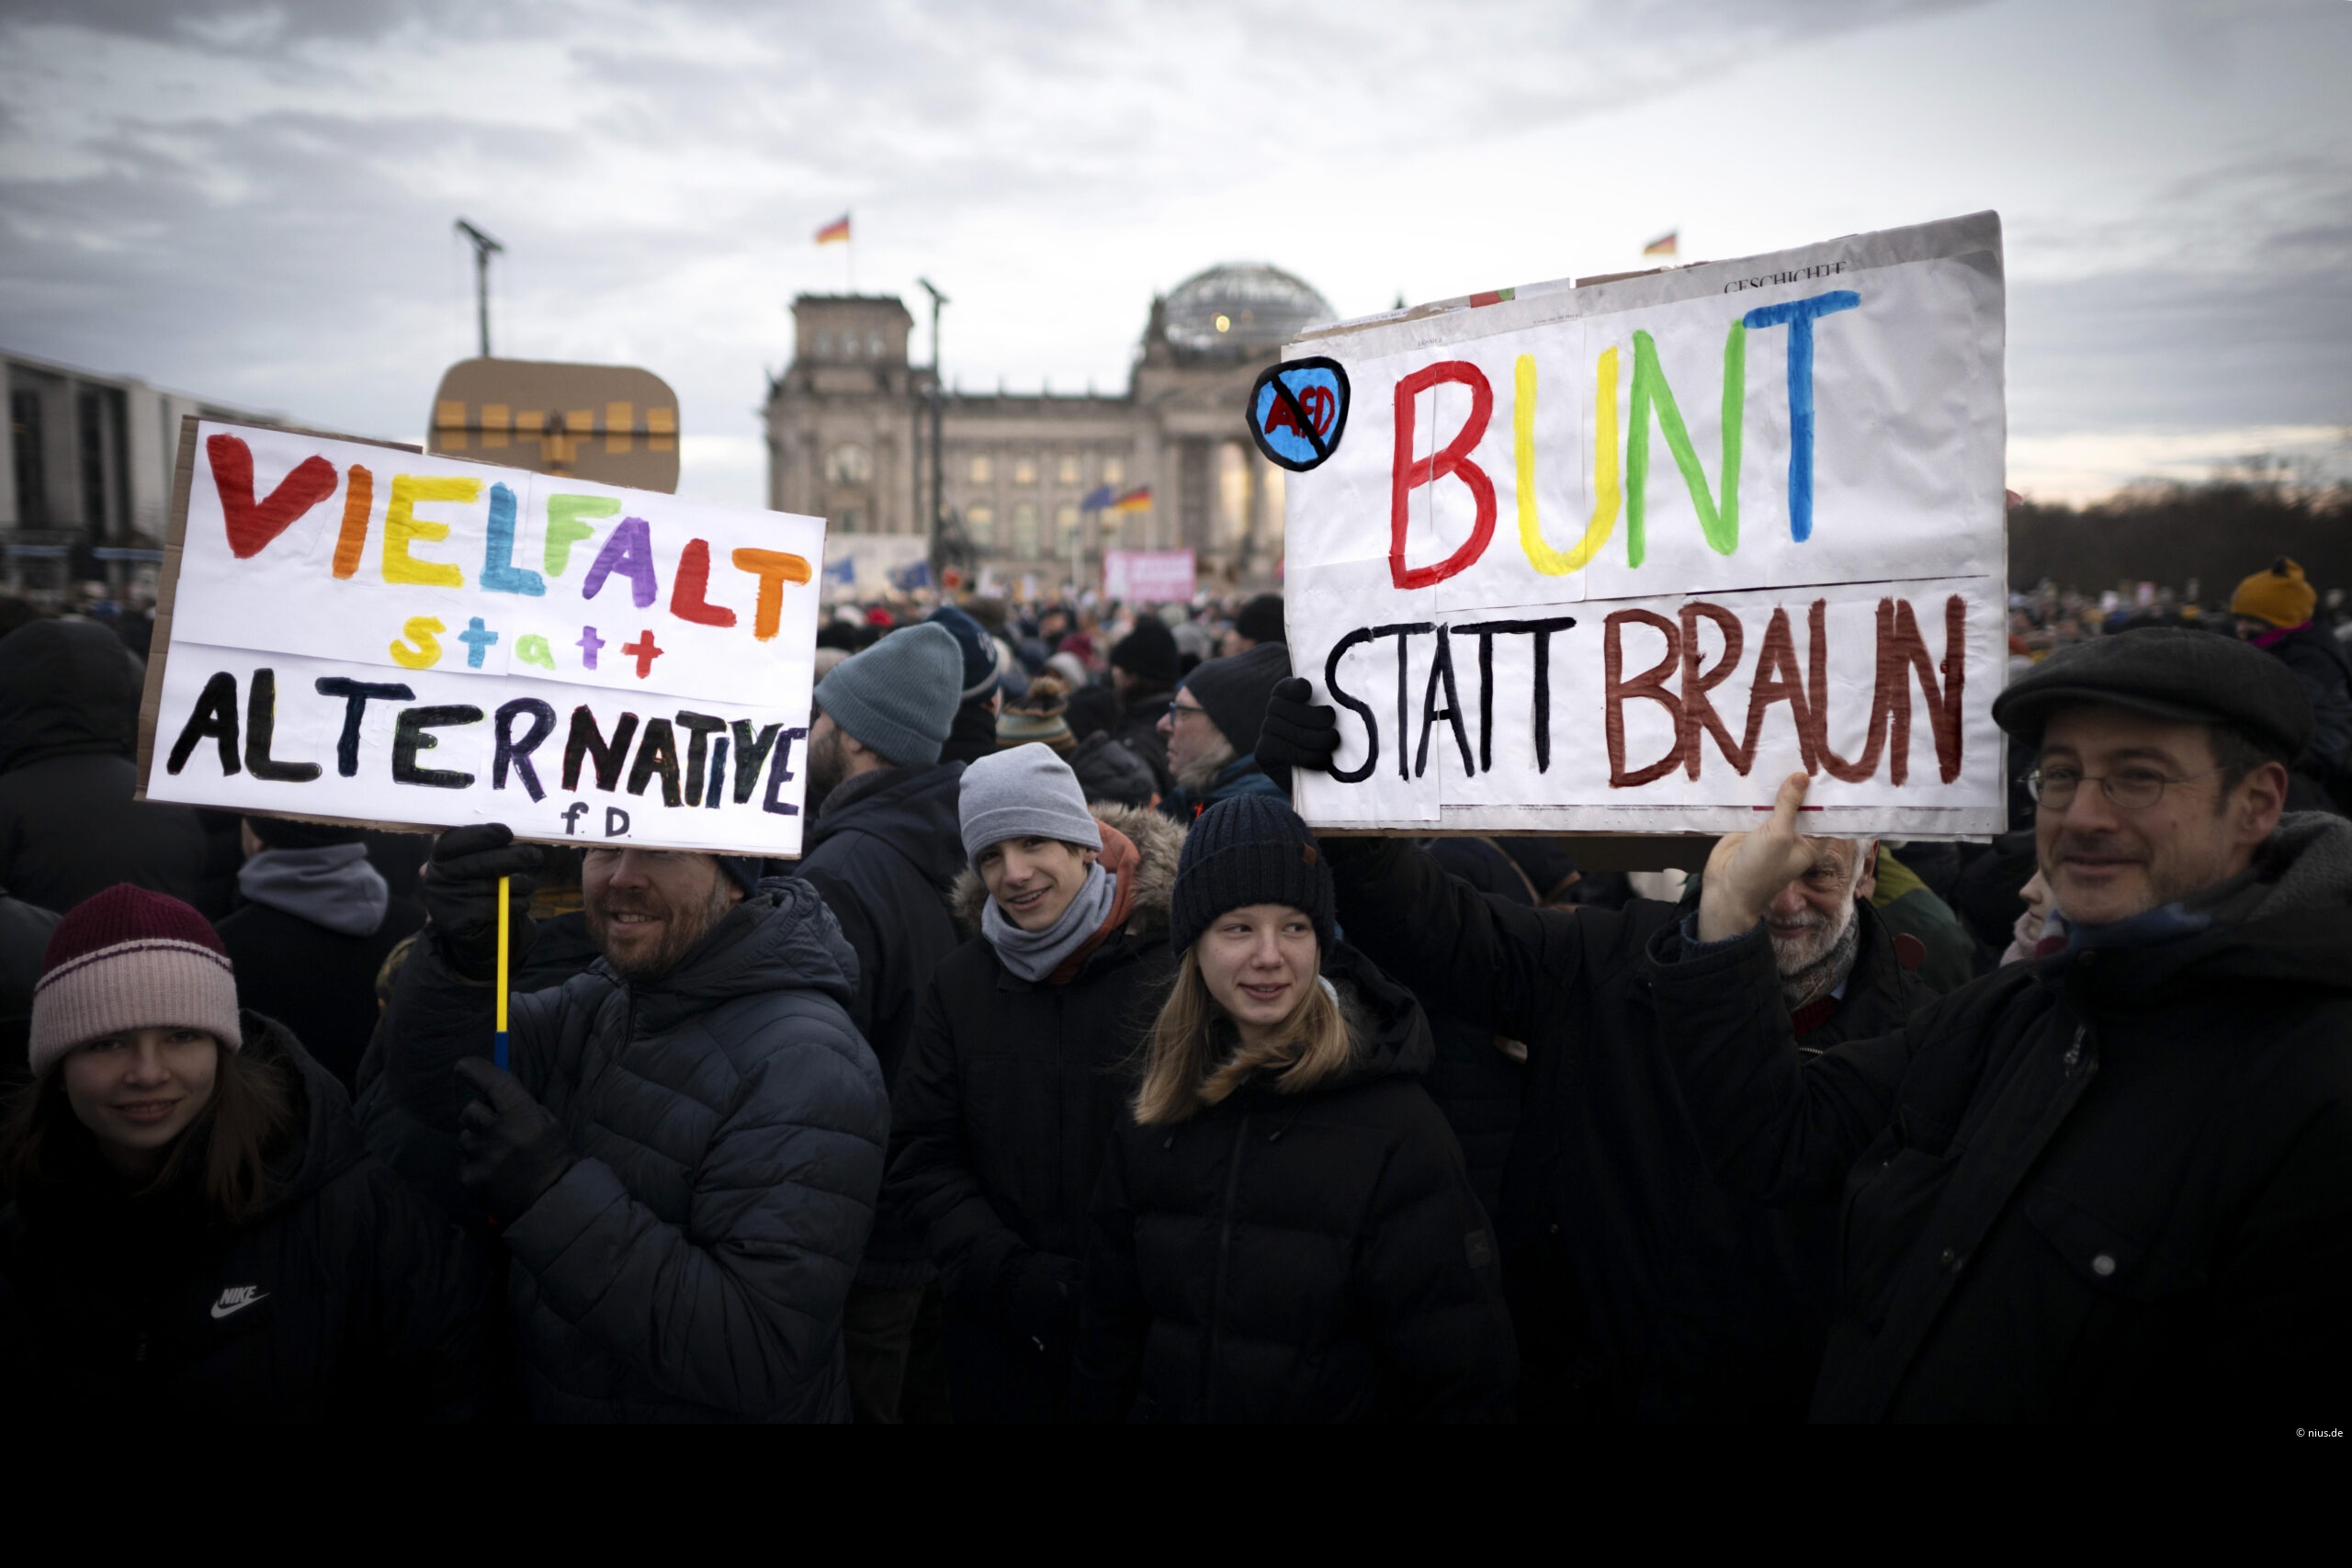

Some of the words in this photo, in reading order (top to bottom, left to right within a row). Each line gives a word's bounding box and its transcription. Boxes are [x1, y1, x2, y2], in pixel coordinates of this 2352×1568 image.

[207, 434, 811, 641] VIELFALT
[1389, 290, 1860, 590] BUNT
[166, 668, 808, 816] ALTERNATIVE
[1325, 617, 1577, 784] STATT
[1604, 592, 1968, 788] BRAUN
[220, 1286, 257, 1304] NIKE
